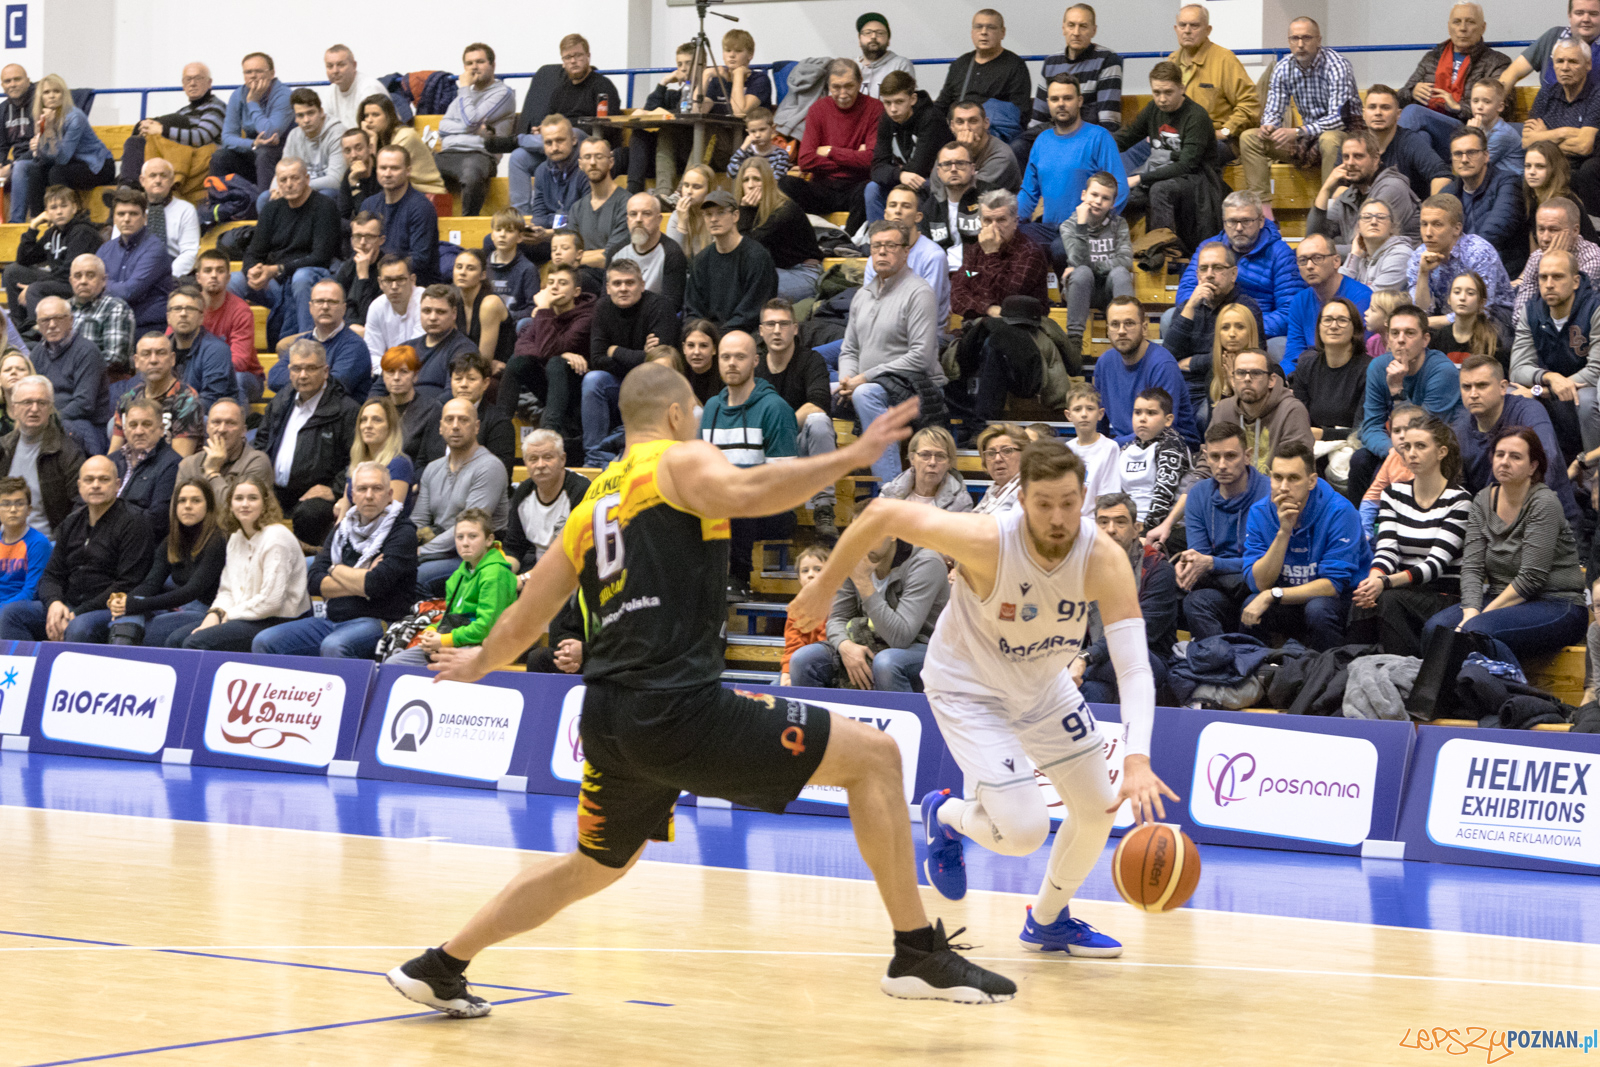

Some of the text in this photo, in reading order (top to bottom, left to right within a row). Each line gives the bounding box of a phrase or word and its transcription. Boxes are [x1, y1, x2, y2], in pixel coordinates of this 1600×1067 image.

[9, 10, 23, 42] C
[594, 492, 624, 578] 6
[52, 689, 158, 719] BIOFARM
[263, 682, 322, 707] leniwej
[255, 700, 322, 730] Danuty
[438, 713, 509, 729] DIAGNOSTYKA
[435, 726, 506, 742] OBRAZOWA
[1258, 776, 1361, 799] posnania
[1466, 757, 1592, 796] HELMEX
[1461, 795, 1586, 824] EXHIBITIONS
[1455, 827, 1582, 847] AGENCJA REKLAMOWA
[1148, 835, 1167, 887] molten
